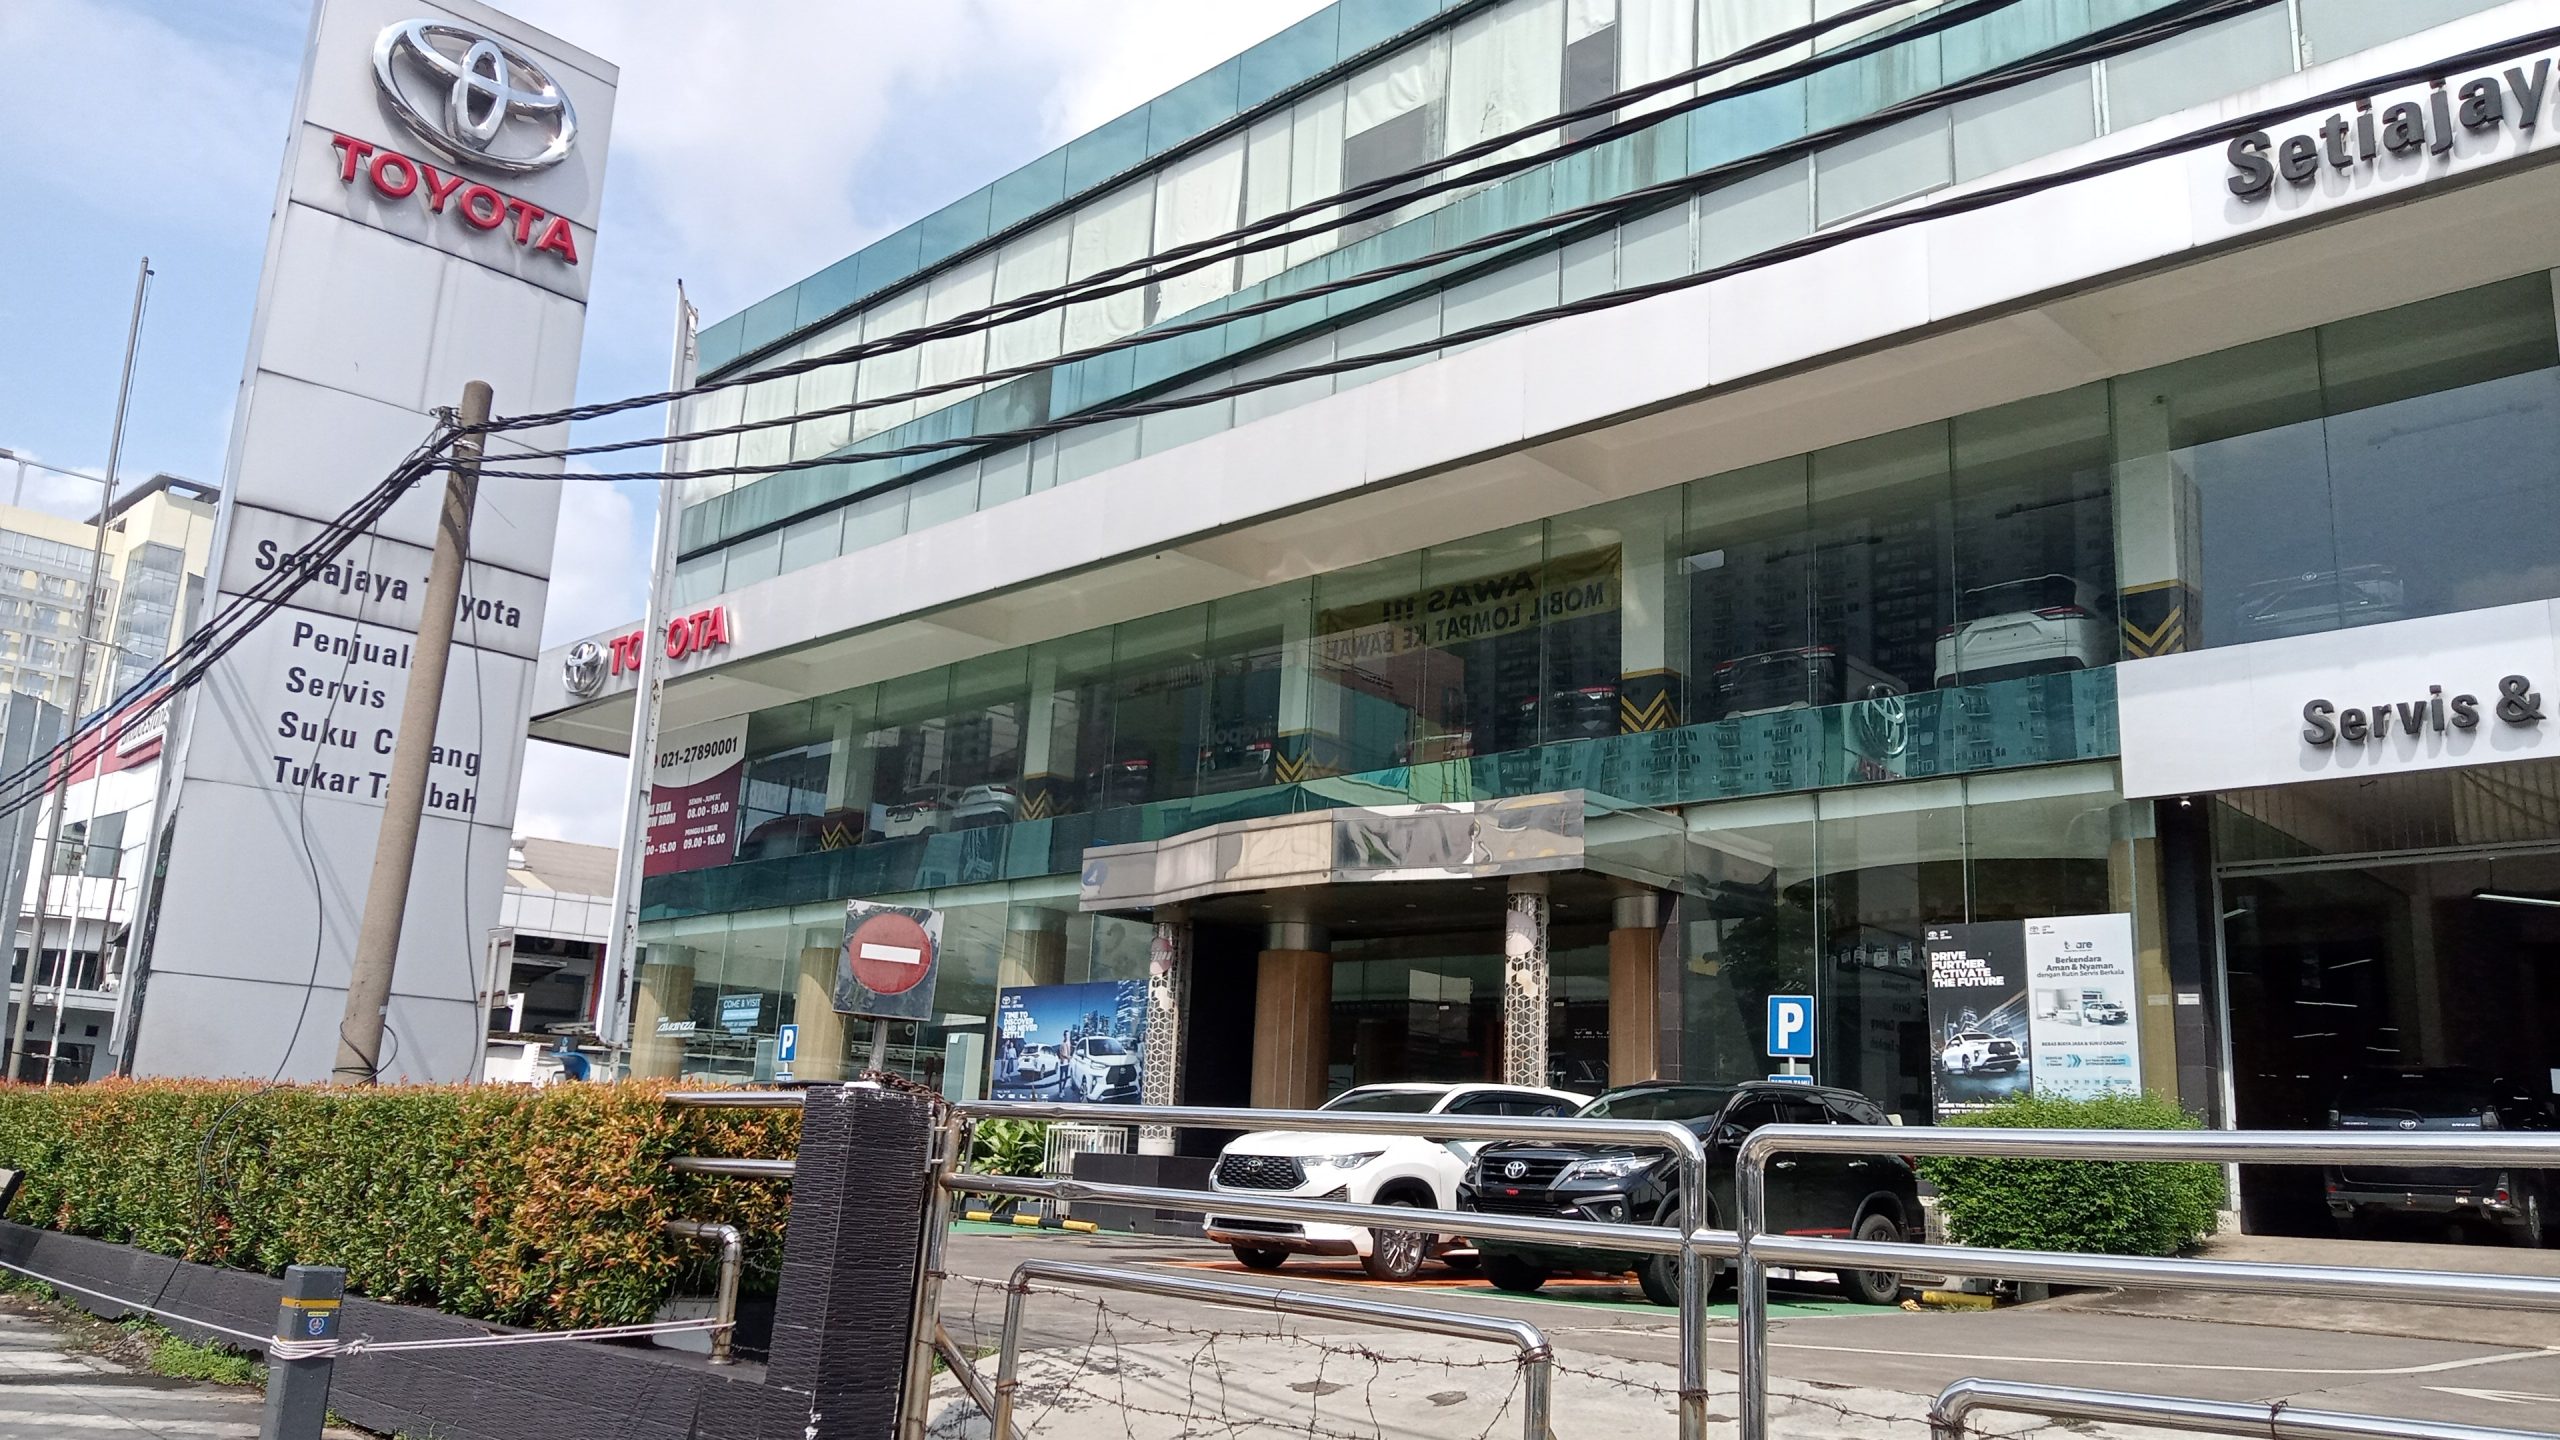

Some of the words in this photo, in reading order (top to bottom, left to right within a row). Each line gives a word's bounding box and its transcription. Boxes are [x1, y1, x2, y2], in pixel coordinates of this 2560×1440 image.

[2227, 58, 2560, 197] Setiajay
[332, 133, 578, 266] TOYOTA
[609, 606, 730, 676] TOOTA
[286, 667, 386, 709] Servis
[2303, 684, 2480, 745] Servis
[2496, 674, 2547, 723] &
[277, 711, 357, 749] Suku
[374, 728, 479, 777] Cang
[661, 736, 738, 769] 021-27890001
[273, 756, 360, 794] Tukar
[368, 772, 477, 815] Tbah
[687, 806, 706, 819] 08.00
[711, 802, 729, 815] 19.00
[683, 837, 703, 850] 09.00
[707, 833, 726, 846] 16.00
[1931, 951, 1967, 962] DRIVE
[1931, 959, 1986, 970] FURTHER
[2046, 964, 2070, 972] Aman
[2079, 963, 2114, 972] Nyaman
[2055, 955, 2102, 964] Berkendara
[1932, 968, 1992, 979] ACTIVATE
[1932, 978, 1956, 988] THE
[1957, 976, 2005, 987] FUTURE
[1777, 1002, 1804, 1050] P
[782, 1029, 794, 1059] P
